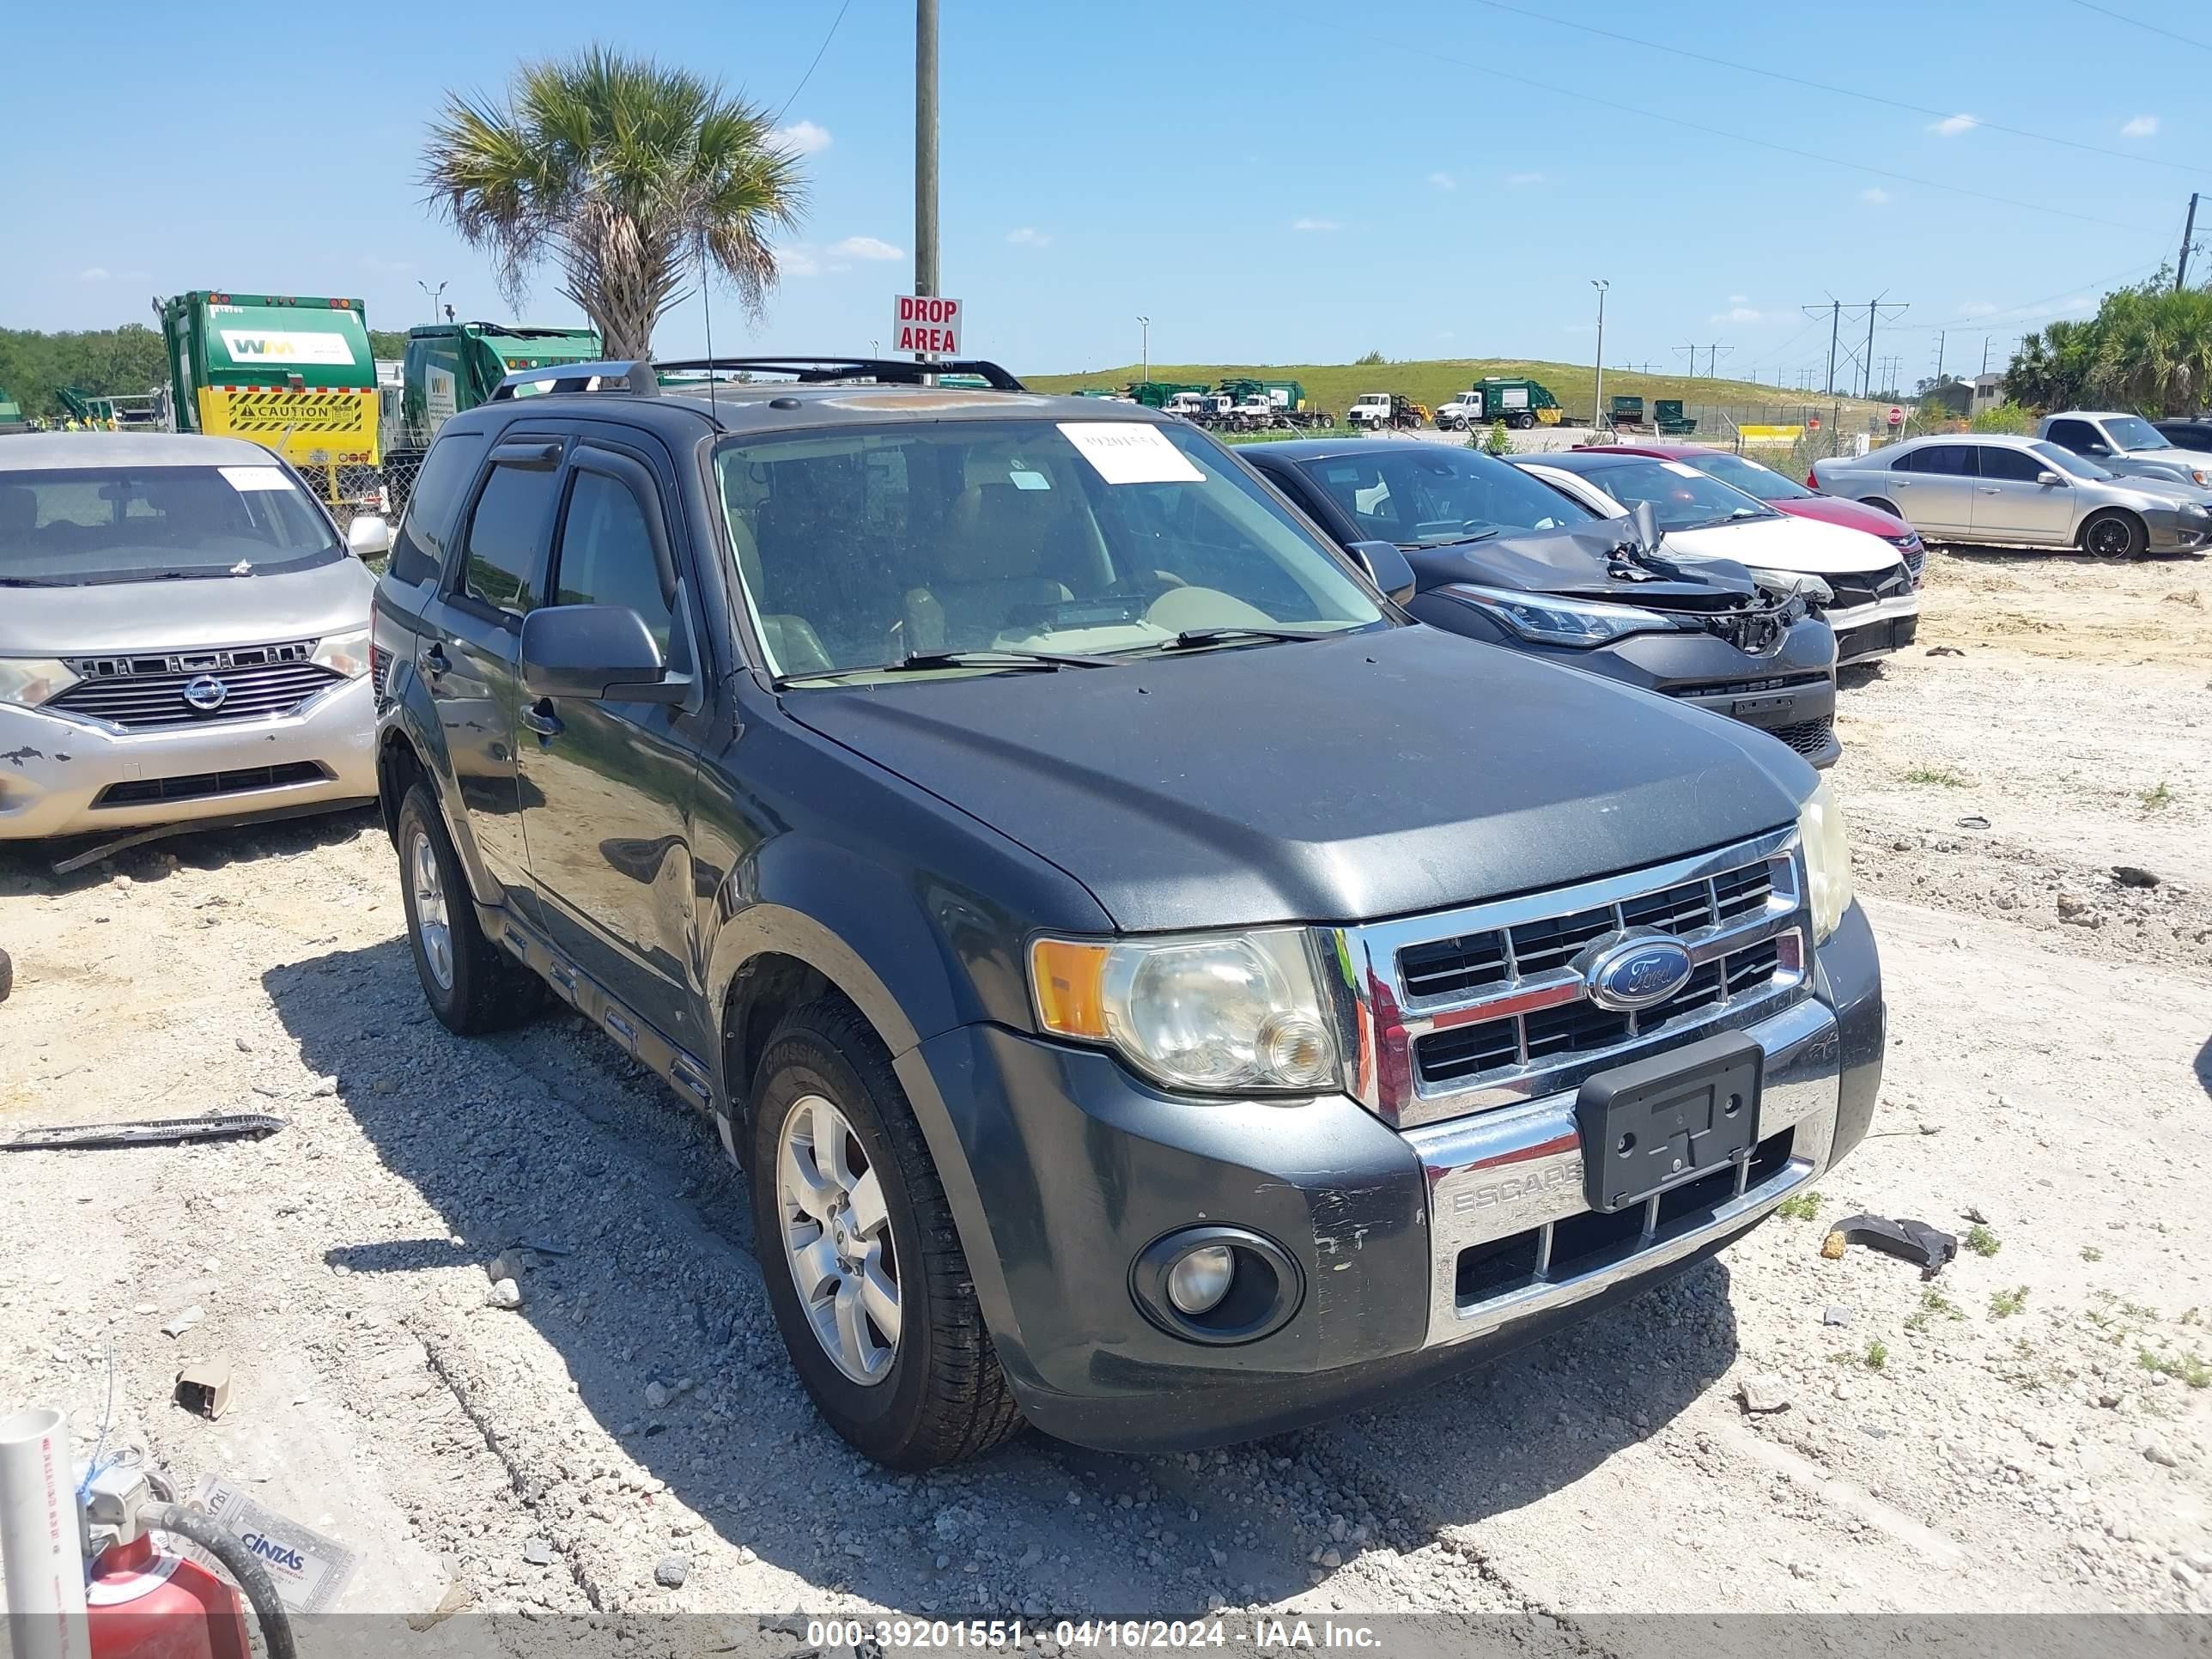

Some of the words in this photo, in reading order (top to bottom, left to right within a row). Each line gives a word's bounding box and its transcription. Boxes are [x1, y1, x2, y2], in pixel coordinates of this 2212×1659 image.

[901, 298, 957, 323] DROP
[233, 339, 295, 355] WM
[900, 327, 955, 352] AREA
[431, 378, 447, 393] WM
[258, 406, 328, 416] CAUTION
[1628, 957, 1673, 993] Ford
[1453, 1160, 1583, 1216] ESCAPE
[241, 1534, 304, 1571] CINTAS
